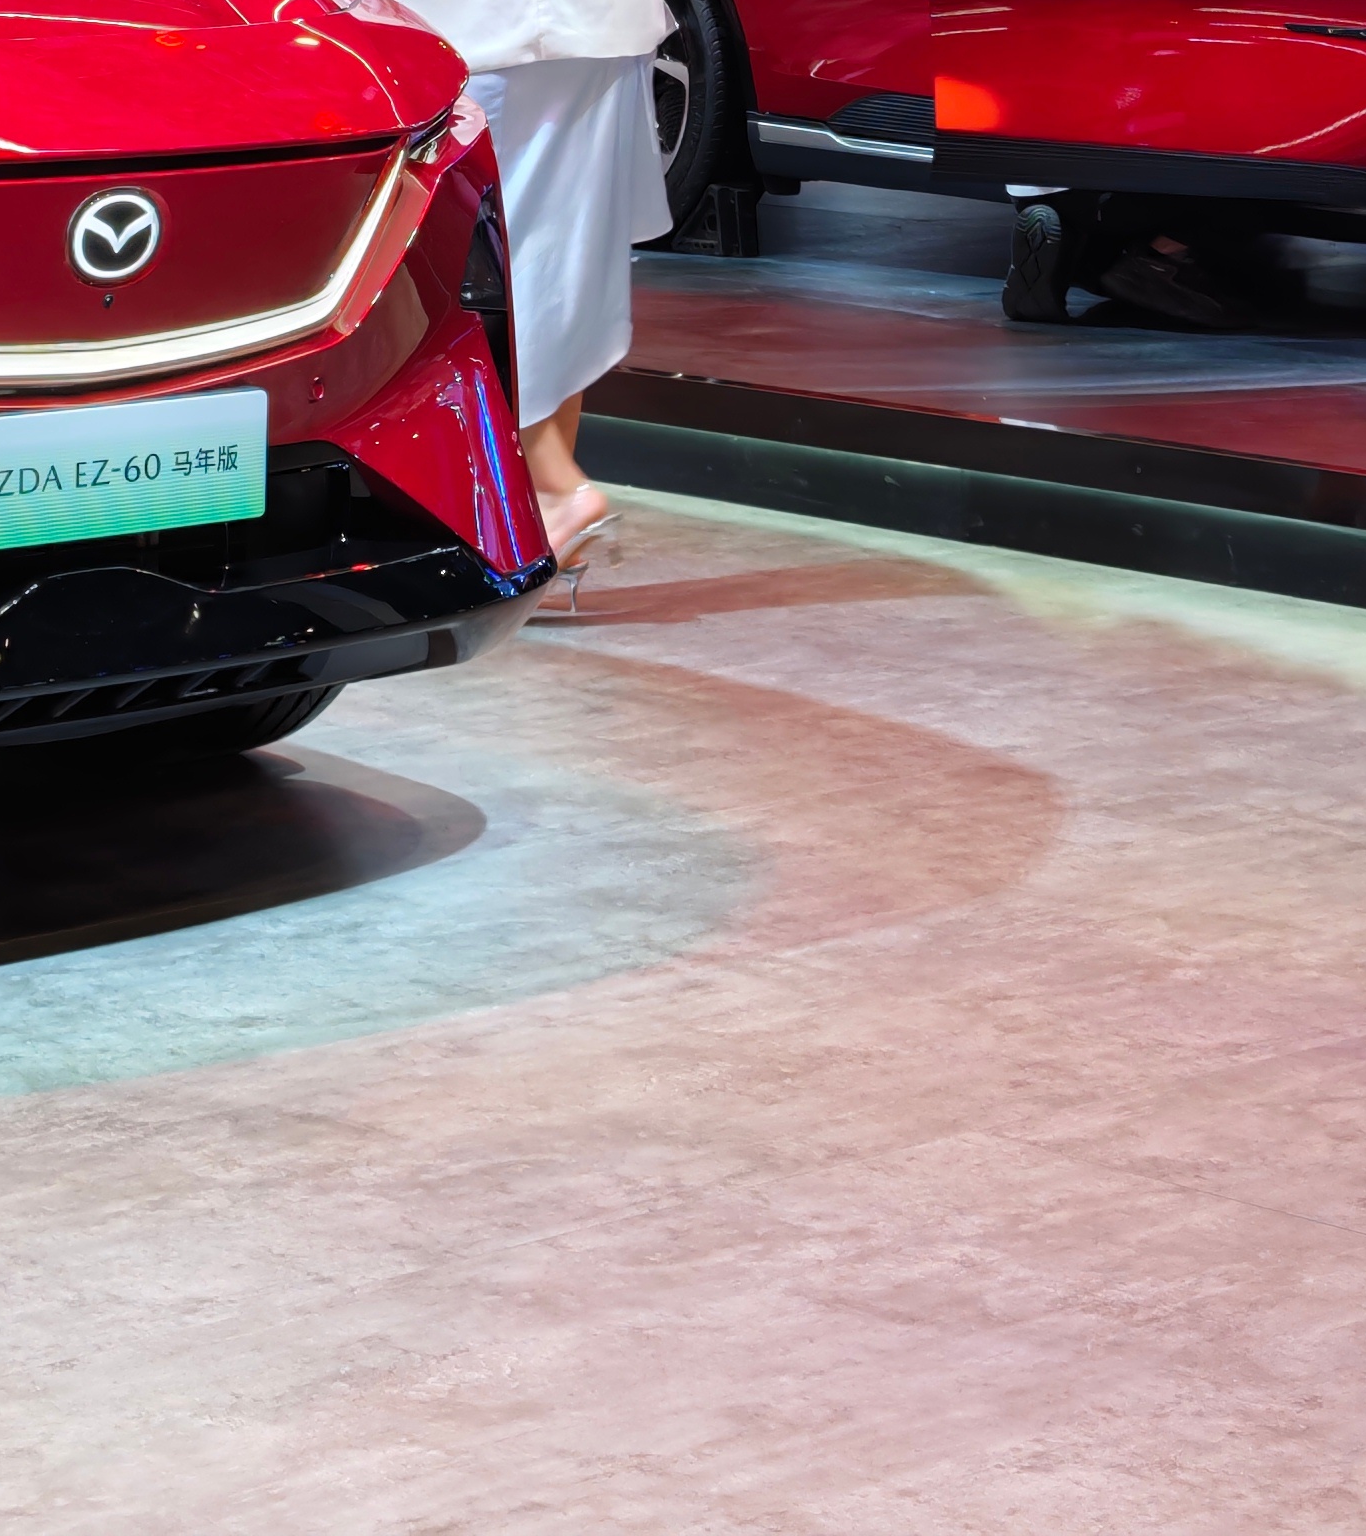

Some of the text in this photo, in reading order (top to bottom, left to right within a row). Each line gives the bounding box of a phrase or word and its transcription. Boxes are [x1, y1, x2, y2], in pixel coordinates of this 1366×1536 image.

[75, 453, 161, 489] EZ-60
[172, 444, 239, 477] 马年版
